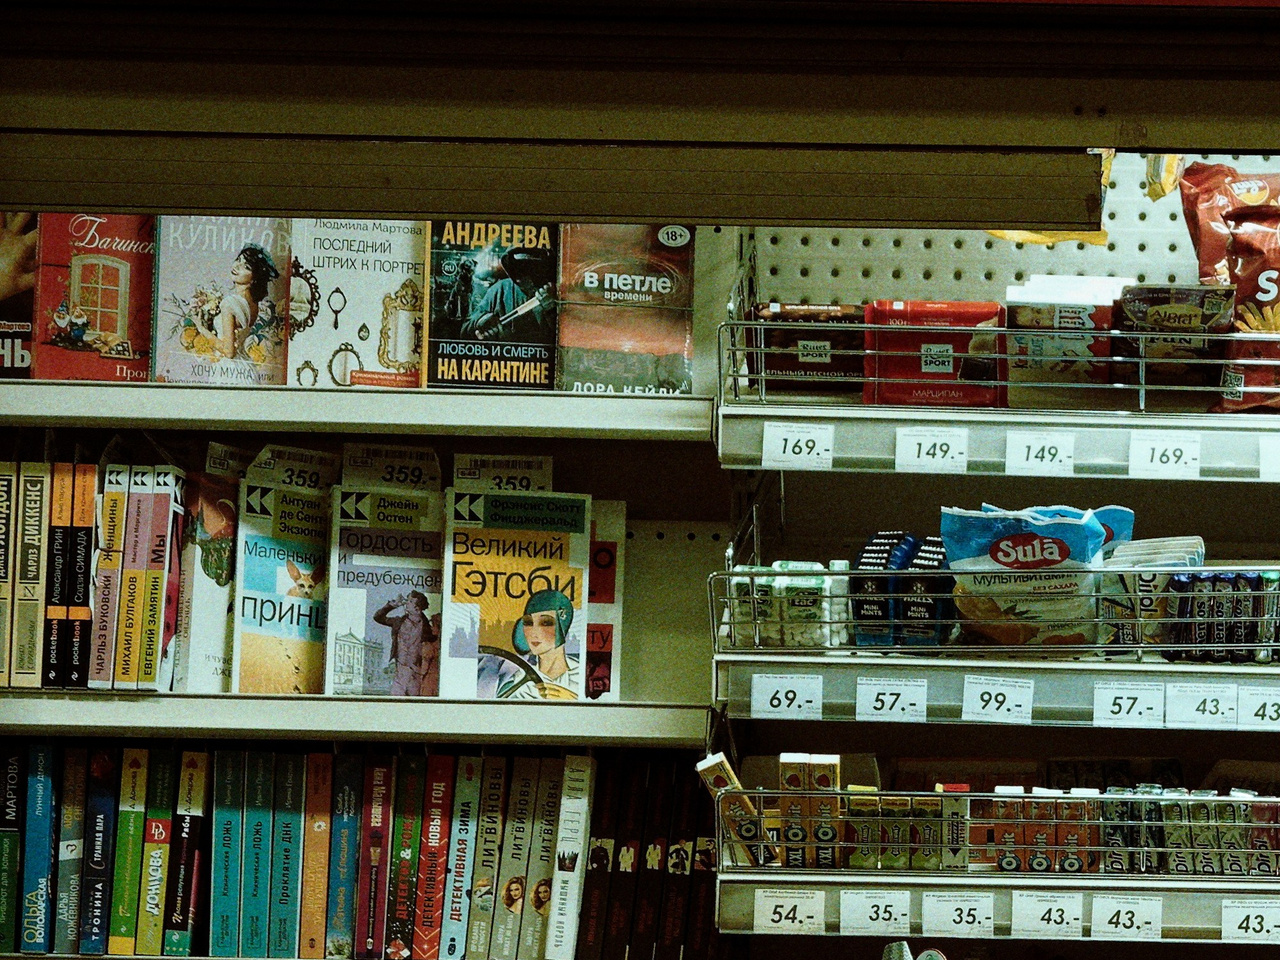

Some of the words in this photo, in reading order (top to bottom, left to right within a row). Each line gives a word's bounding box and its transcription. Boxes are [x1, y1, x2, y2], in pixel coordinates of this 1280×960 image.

[314, 219, 368, 232] Людмила
[371, 221, 422, 235] Мартова
[442, 222, 551, 249] АНДРЕЕВА
[664, 230, 684, 241] 18+
[313, 237, 392, 254] ПОСЛЕДНИЙ
[312, 256, 357, 269] ШТРИХ
[362, 258, 370, 269] К
[584, 274, 598, 288] в
[604, 274, 672, 294] петле
[604, 292, 653, 302] времени
[437, 344, 489, 356] ЛЮБОВЬ
[491, 345, 500, 356] И
[503, 346, 548, 359] СМЕРТЬ
[191, 364, 216, 376] ХОЧУ
[437, 358, 458, 379] НА
[461, 359, 548, 384] КАРАНТИНЕ
[923, 359, 952, 368] SPORT
[911, 389, 964, 399] МАРЦИПАН
[781, 438, 831, 457] 169.-
[915, 442, 965, 460] 149.-
[1149, 447, 1199, 466] 169.-
[282, 467, 332, 491] 359.-
[381, 464, 438, 484] 359.-
[280, 494, 321, 510] Антуан
[376, 497, 419, 513] Джейн
[544, 501, 582, 515] Скотт
[24, 482, 42, 546] ДИККЕНС
[279, 509, 294, 521] де
[376, 512, 414, 525] Остен
[489, 514, 579, 529] Фицджеральд
[103, 498, 118, 563] Женщины
[55, 529, 63, 557] ГРИН
[75, 530, 87, 572] СИМАДА
[151, 534, 165, 564] Мы
[339, 529, 434, 556] Гордость
[451, 532, 564, 561] Великий
[27, 547, 39, 579] ЧАРЛЗ
[338, 551, 348, 565] и
[52, 558, 63, 604] Александр
[451, 560, 576, 603] Гэтсби
[98, 575, 112, 632] БУКОВСКИ
[124, 576, 137, 634] БУЛГАКОВ
[148, 576, 160, 626] ЗАМЯТИН
[49, 620, 58, 664] pocketbook
[95, 633, 108, 675] ЧАРЛЬЗ
[122, 635, 132, 676] МИХАИЛ
[143, 629, 155, 677] ЕВГЕНИЙ
[769, 690, 813, 709] 69.-
[980, 691, 1023, 712] 99.-
[1110, 696, 1154, 717] 57.-
[1195, 698, 1235, 717] 43.-
[5, 756, 19, 821] МАРТОВА
[432, 782, 446, 803] ГОД
[35, 783, 43, 816] ЛУННЫЙ
[428, 808, 442, 847] НОВЫЙ
[482, 767, 503, 869] ЛИТВИНОВЫ
[282, 821, 292, 844] ДНК
[450, 838, 468, 923] ДЕТЕКТИВНАЯ
[459, 801, 471, 835] ЗИМА
[279, 848, 291, 905] Проклятие
[422, 851, 438, 928] ДЕТЕКТИВНЫЙ
[770, 904, 814, 924] 54.-
[869, 904, 908, 921] 35.-
[1107, 910, 1152, 931] 43.-
